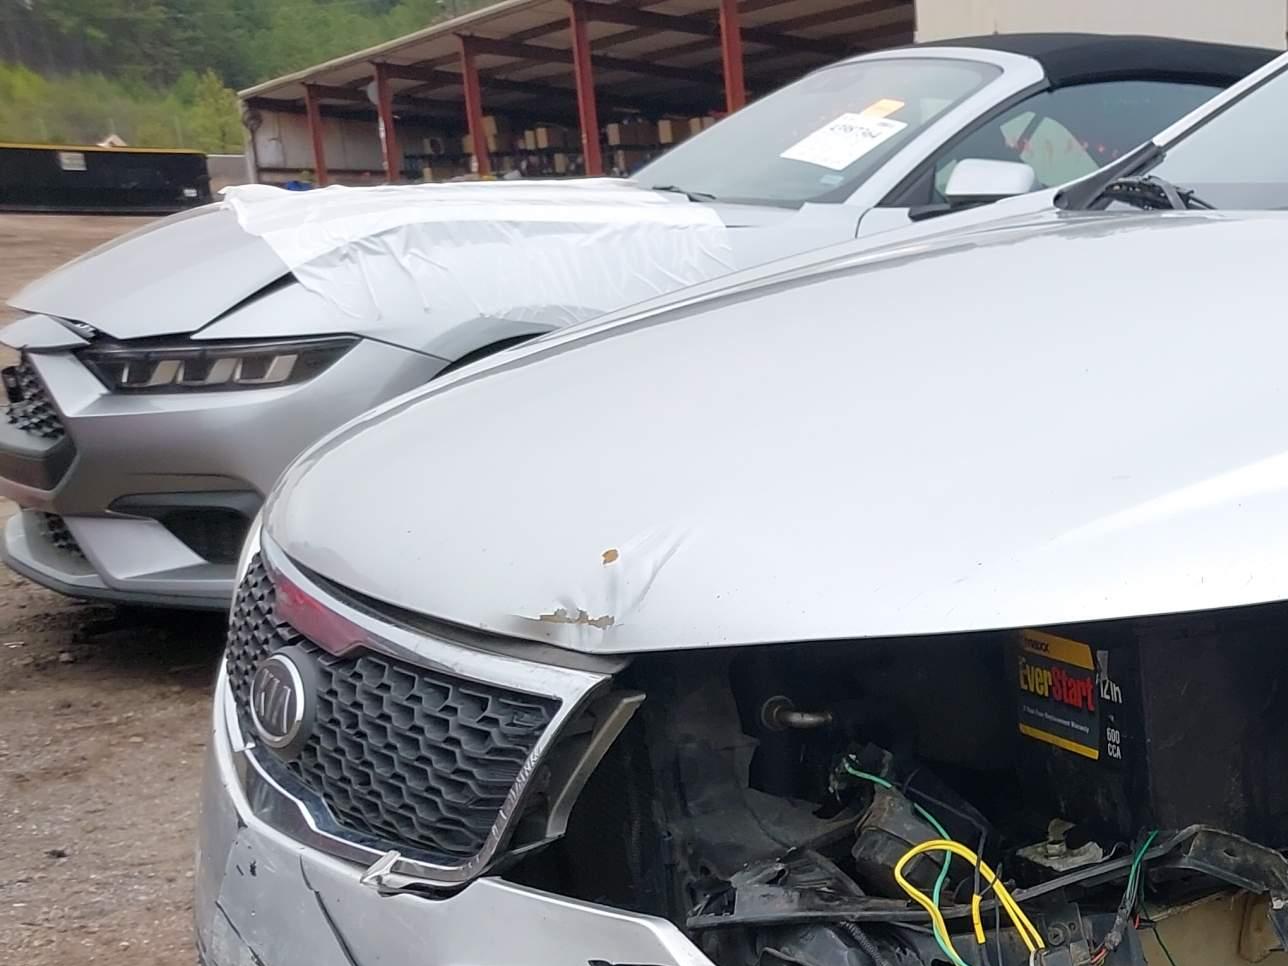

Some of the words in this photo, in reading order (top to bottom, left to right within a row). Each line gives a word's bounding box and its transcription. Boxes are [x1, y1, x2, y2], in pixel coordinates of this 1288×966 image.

[1018, 656, 1096, 712] EverStart
[1106, 727, 1121, 745] 600
[1107, 743, 1122, 760] CCA
